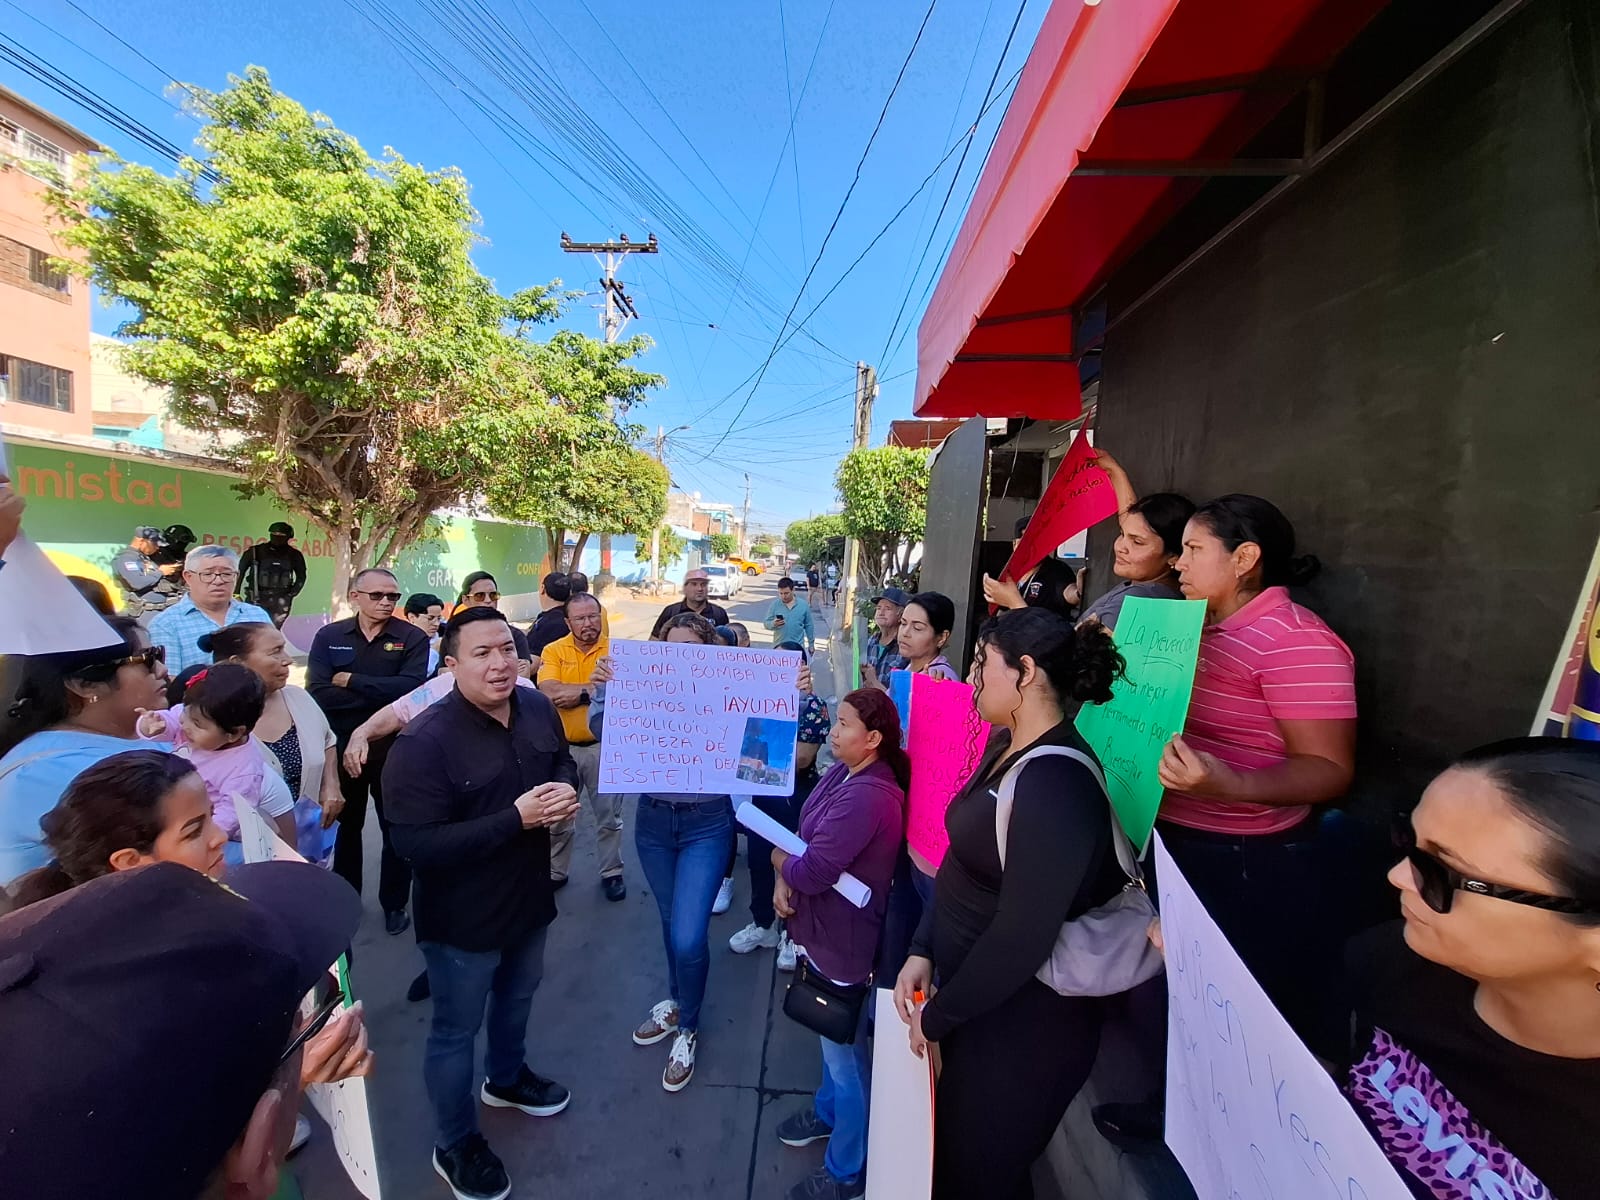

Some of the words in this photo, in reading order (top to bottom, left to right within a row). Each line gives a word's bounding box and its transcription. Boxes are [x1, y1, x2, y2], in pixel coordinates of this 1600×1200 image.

[16, 460, 184, 509] mistad
[202, 533, 336, 558] RESPOSABIL
[427, 569, 454, 588] GRA
[1123, 607, 1146, 646] La
[612, 643, 631, 656] EL
[639, 644, 706, 660] EDIFICIO
[612, 660, 630, 673] ES
[639, 662, 677, 676] UNA
[690, 663, 756, 682] BOMBA
[769, 671, 792, 684] DE
[610, 696, 686, 713] PEDIMOS
[694, 703, 714, 717] LA
[608, 732, 693, 750] LIMPIEZA
[705, 740, 729, 753] DE
[721, 725, 730, 742] Y
[604, 751, 624, 764] LA
[638, 751, 704, 766] TIENDA
